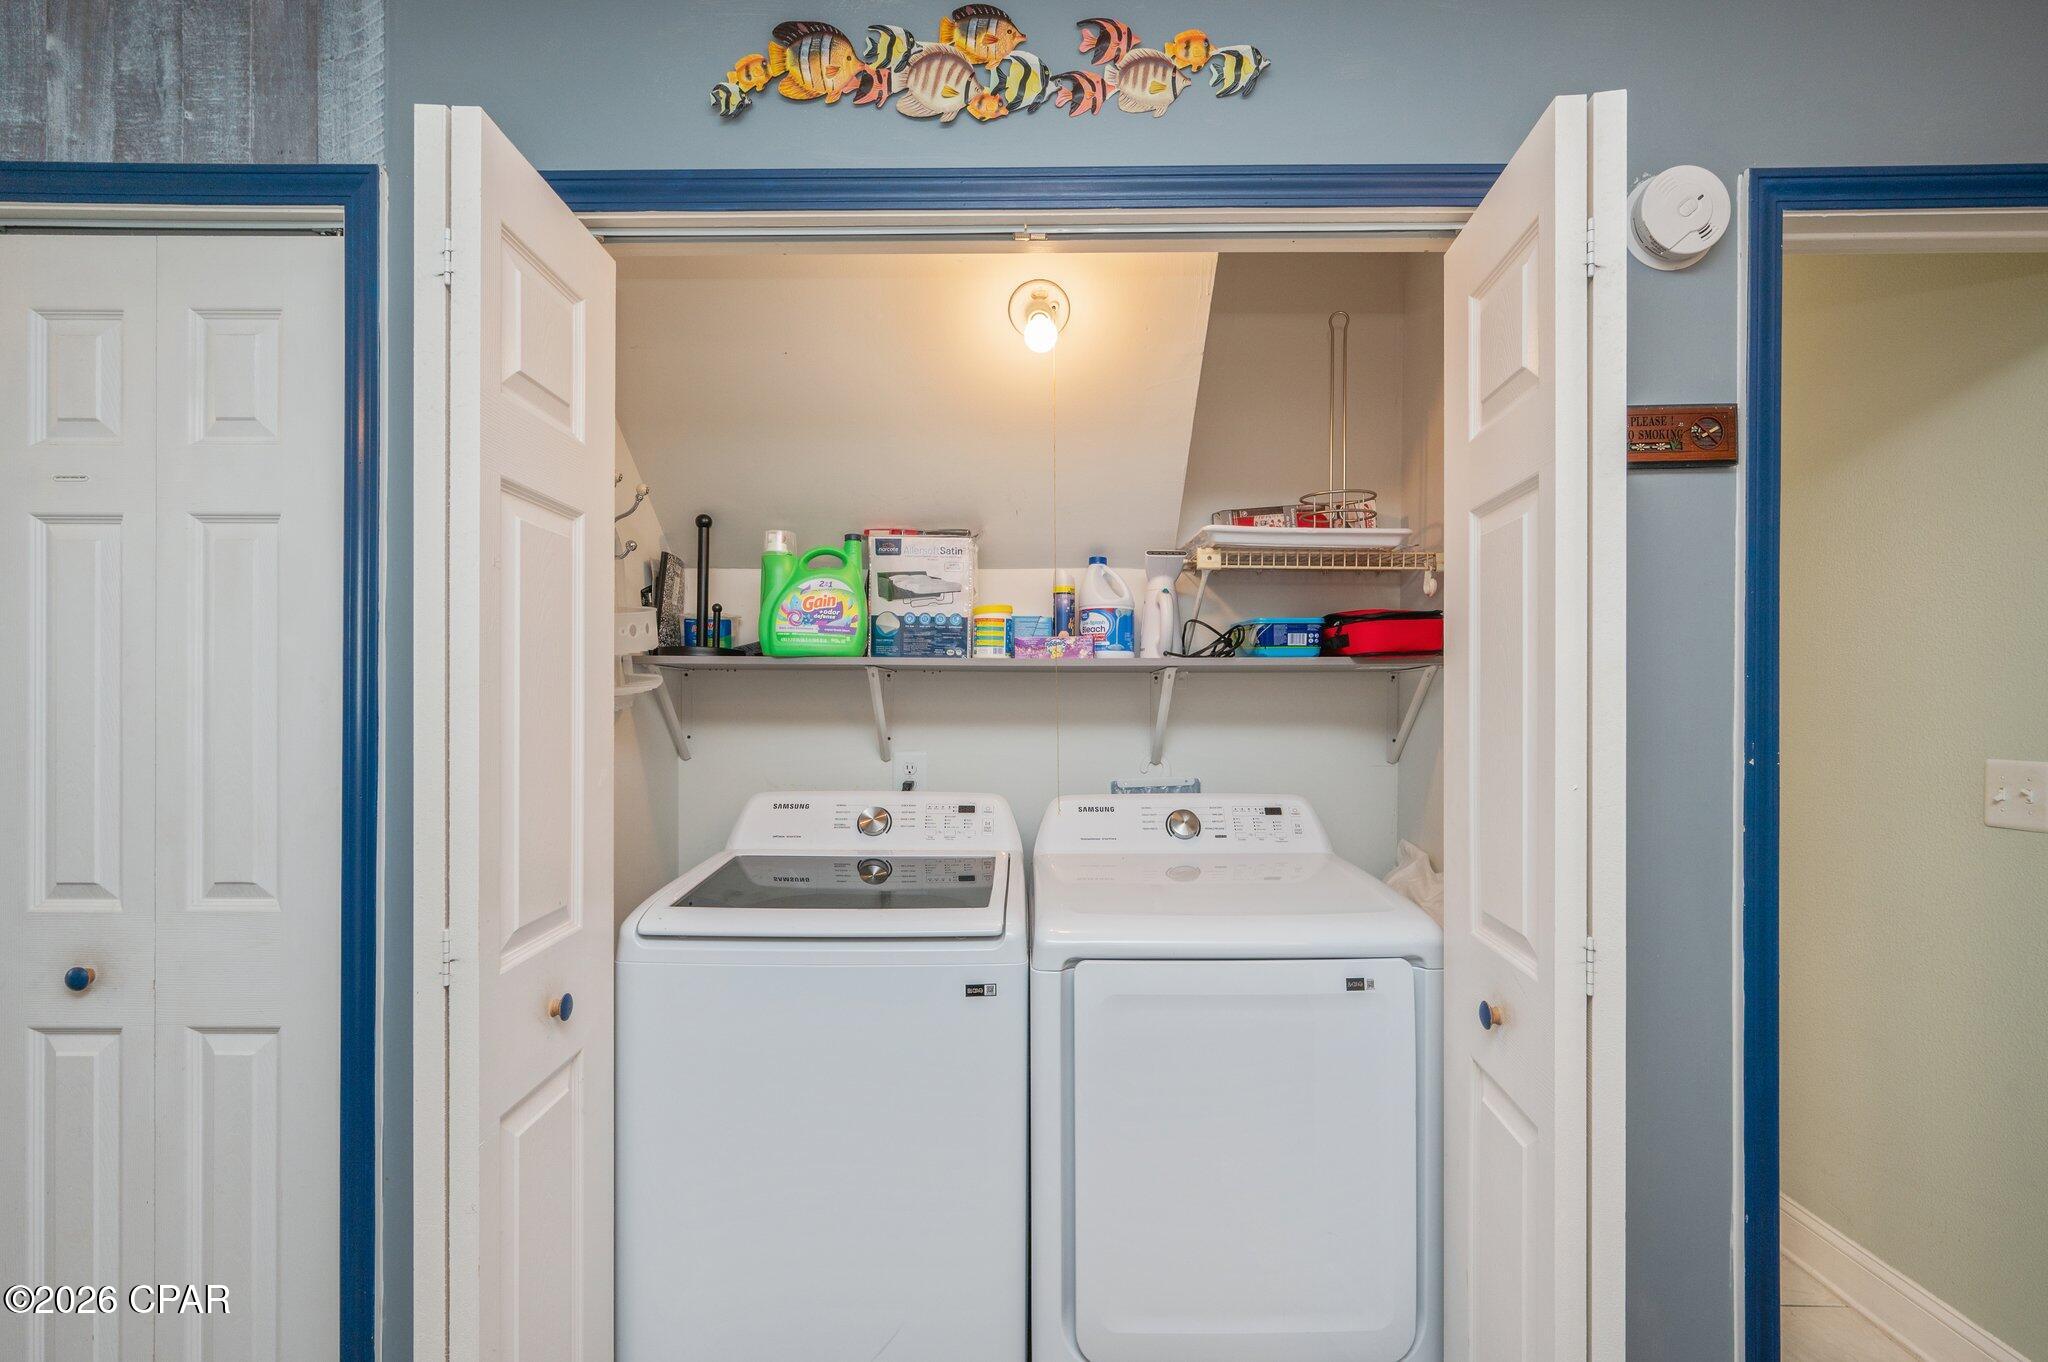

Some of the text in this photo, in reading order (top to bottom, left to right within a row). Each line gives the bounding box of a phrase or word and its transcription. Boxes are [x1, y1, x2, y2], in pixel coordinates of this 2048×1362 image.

[1630, 416, 1667, 427] PLEASE
[1638, 429, 1684, 440] SMOKING
[939, 546, 963, 555] Satin
[802, 594, 838, 612] Gain
